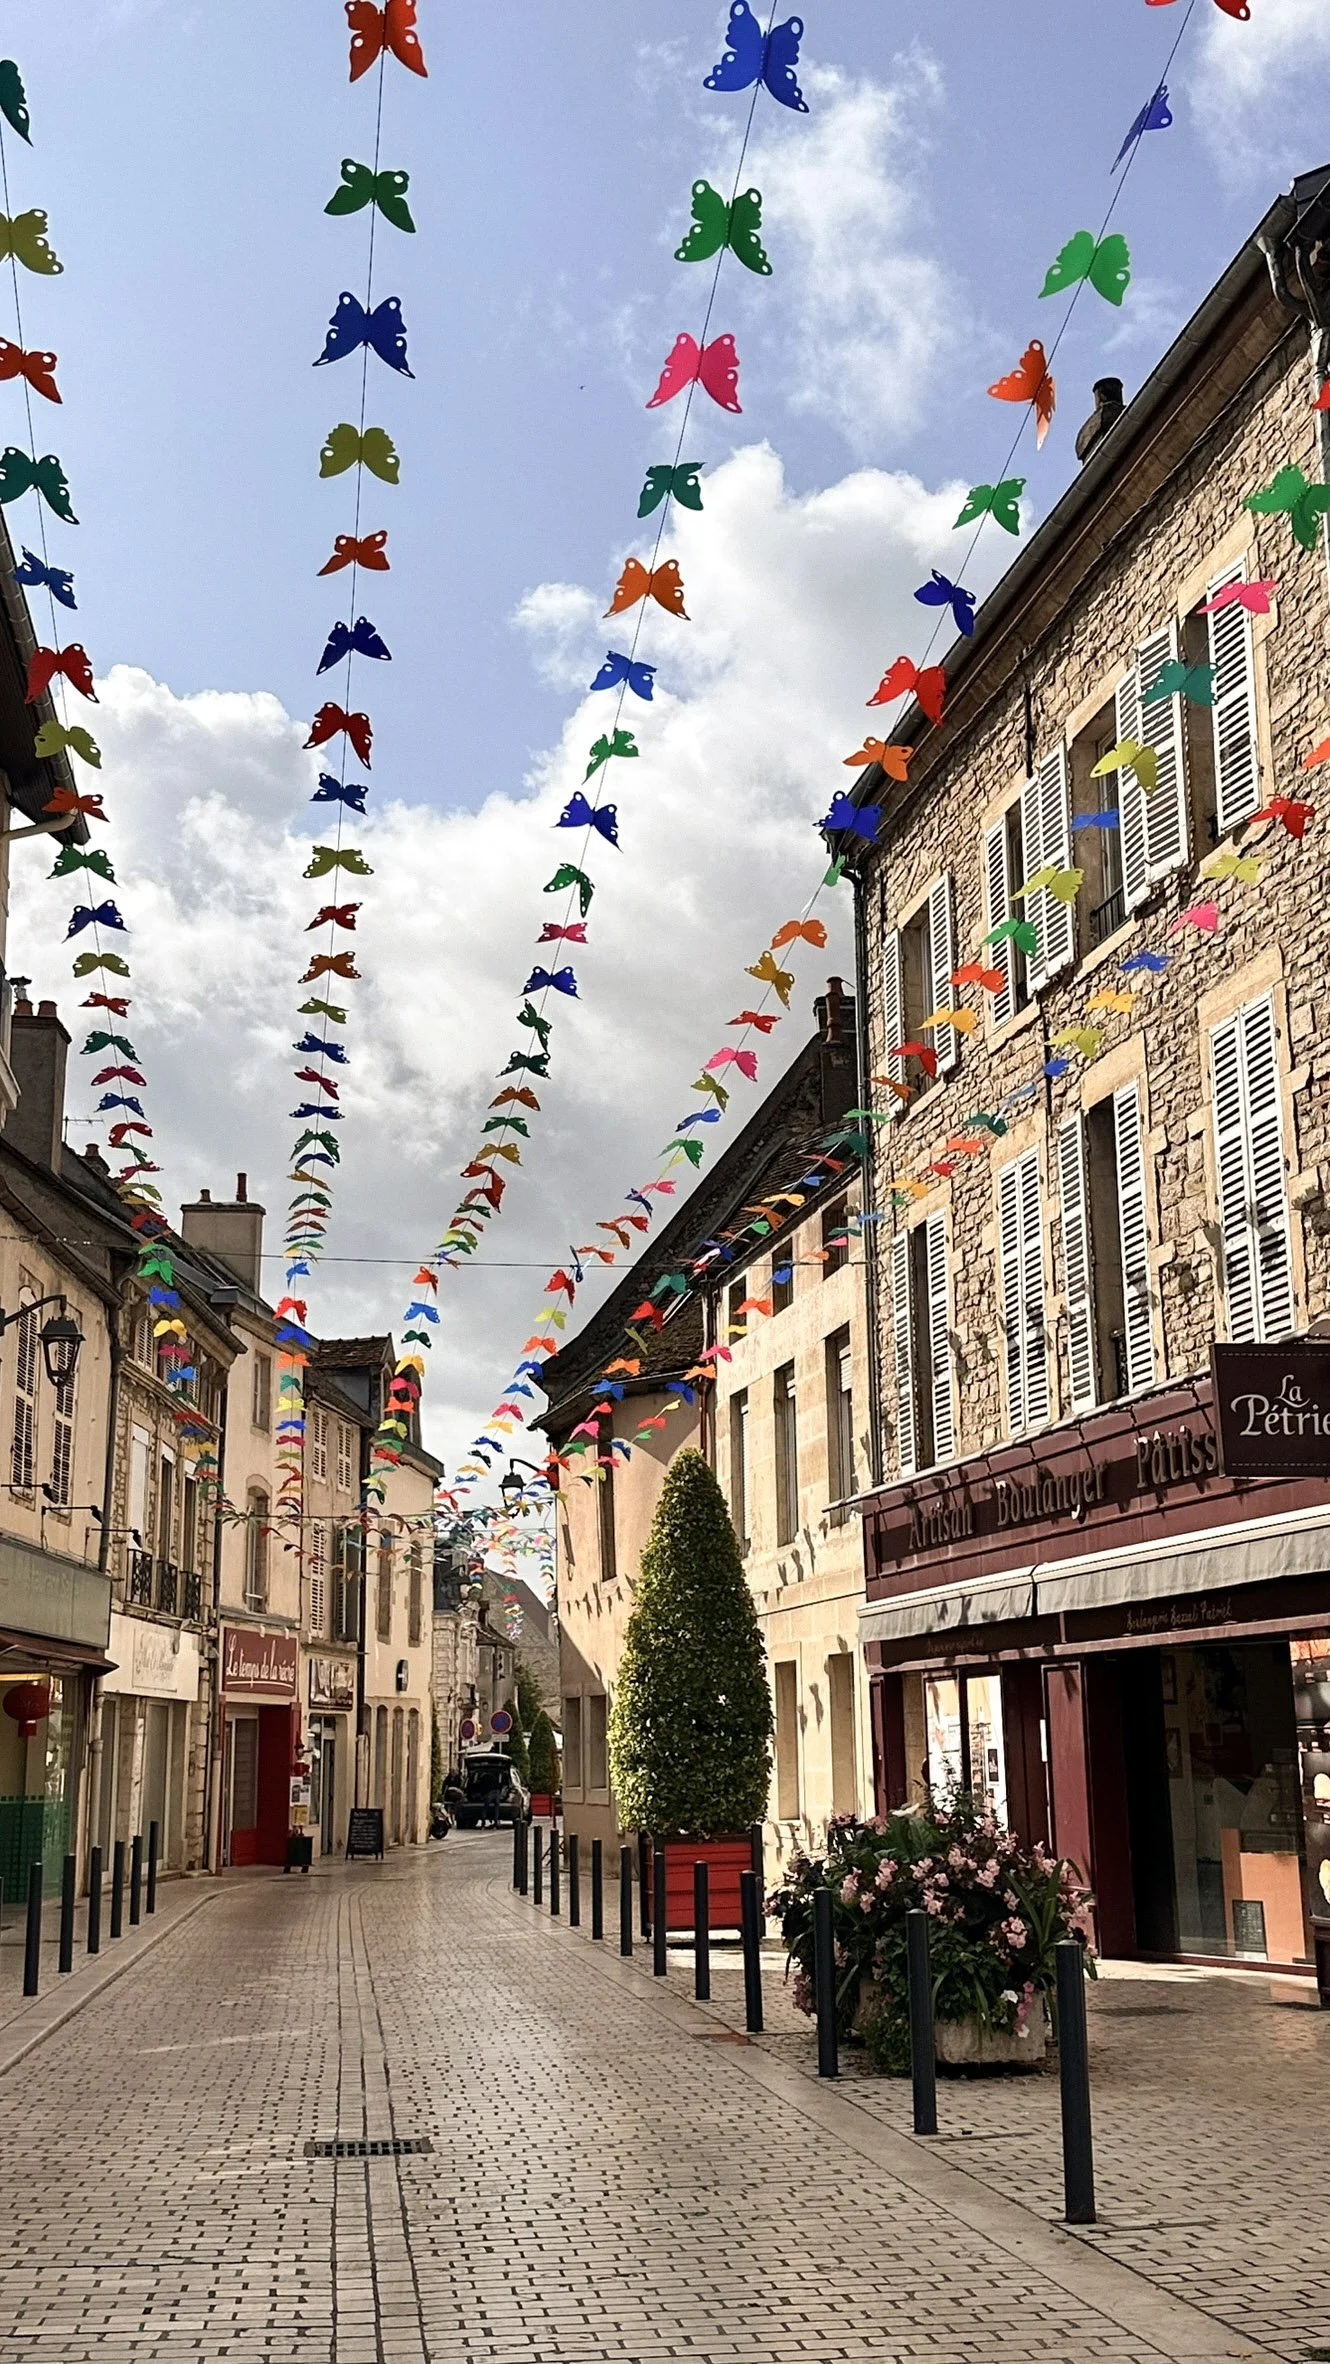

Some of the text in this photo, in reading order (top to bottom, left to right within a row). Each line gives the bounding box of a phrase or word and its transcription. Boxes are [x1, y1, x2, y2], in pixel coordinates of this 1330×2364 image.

[1274, 1374, 1310, 1408] La
[908, 1500, 975, 1550] Artisan
[996, 1464, 1107, 1527] Boulanger
[225, 1634, 295, 1688] Le temps de la récré
